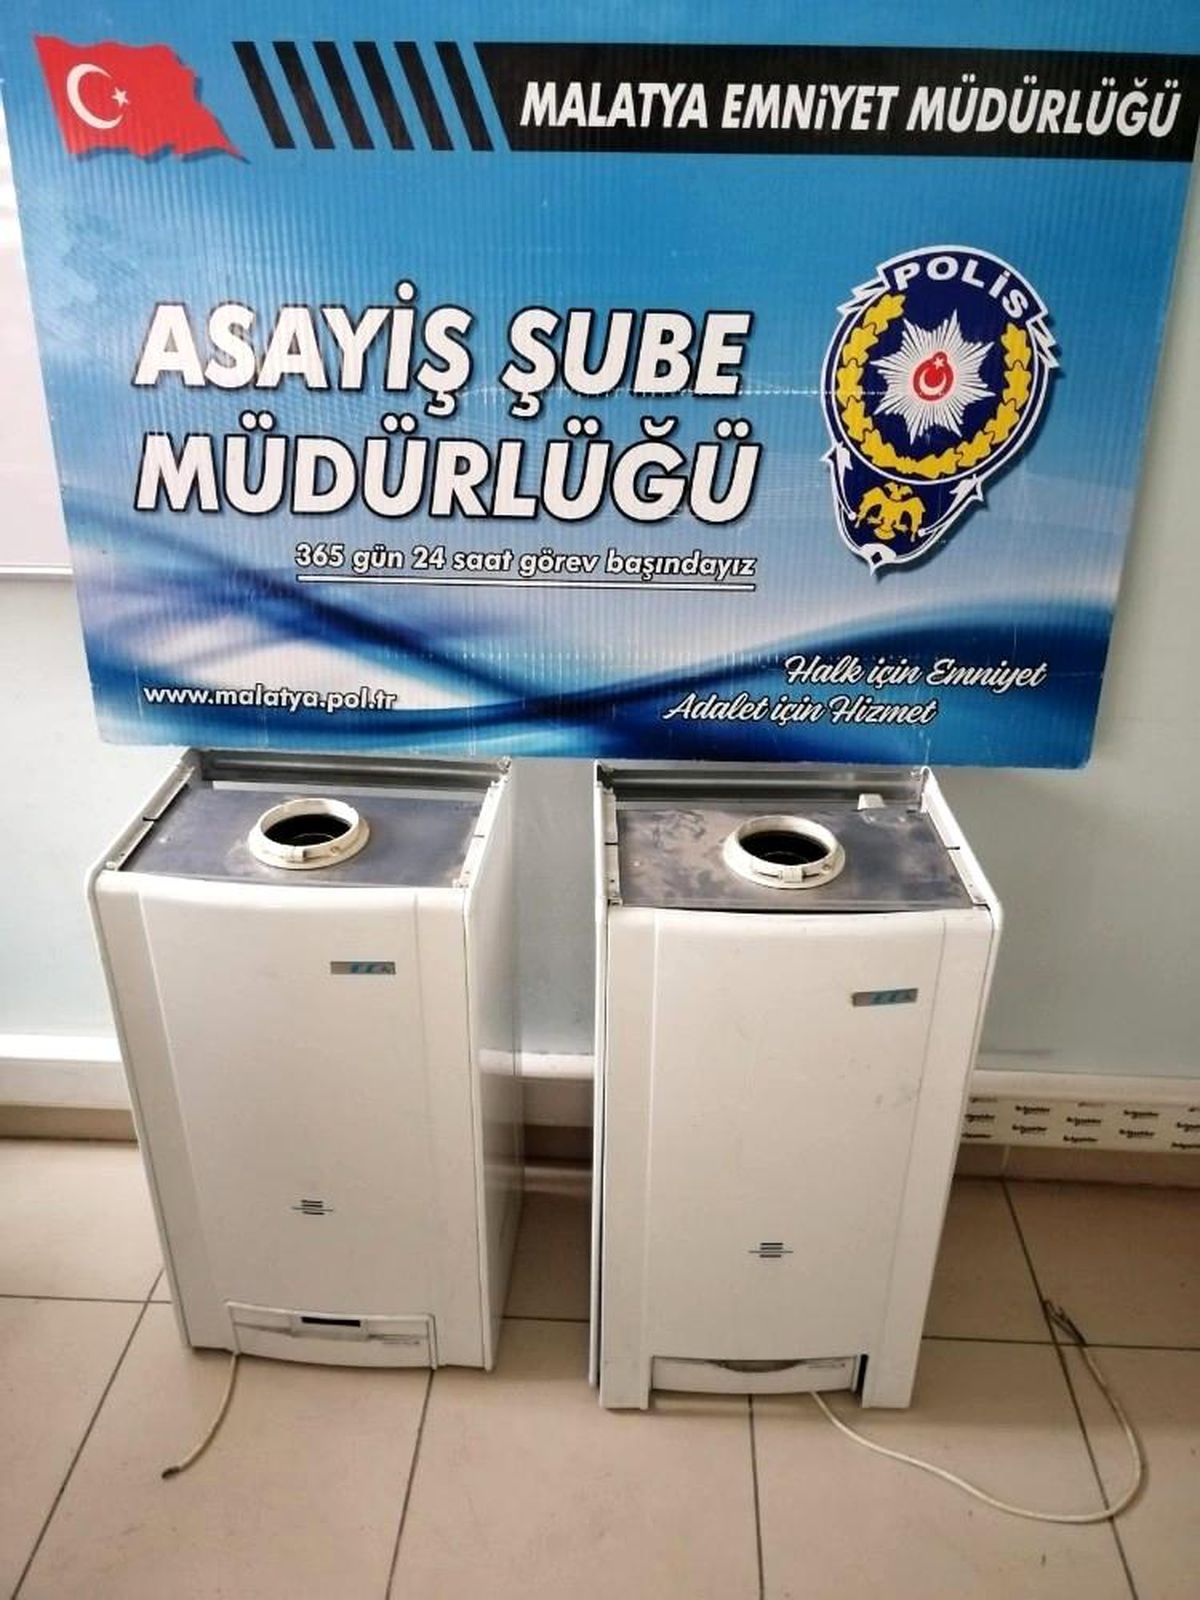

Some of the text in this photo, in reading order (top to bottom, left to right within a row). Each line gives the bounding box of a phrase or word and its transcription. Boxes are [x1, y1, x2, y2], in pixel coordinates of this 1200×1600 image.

[520, 82, 709, 128] MALATYA
[908, 74, 1182, 137] MÜDÜRLÜĞÜ
[892, 255, 1030, 319] POLİS
[133, 280, 754, 417] ASAYİŞ ŞUBE
[134, 410, 764, 523] MÜDÜRLÜĞÜ
[295, 543, 757, 581] 365 gün 24 saat görev başındayız
[143, 682, 398, 712] www.malatya.pol.tr
[784, 655, 1048, 693] Halk için Emniyet
[662, 693, 938, 726] Adalet için Hizmet
